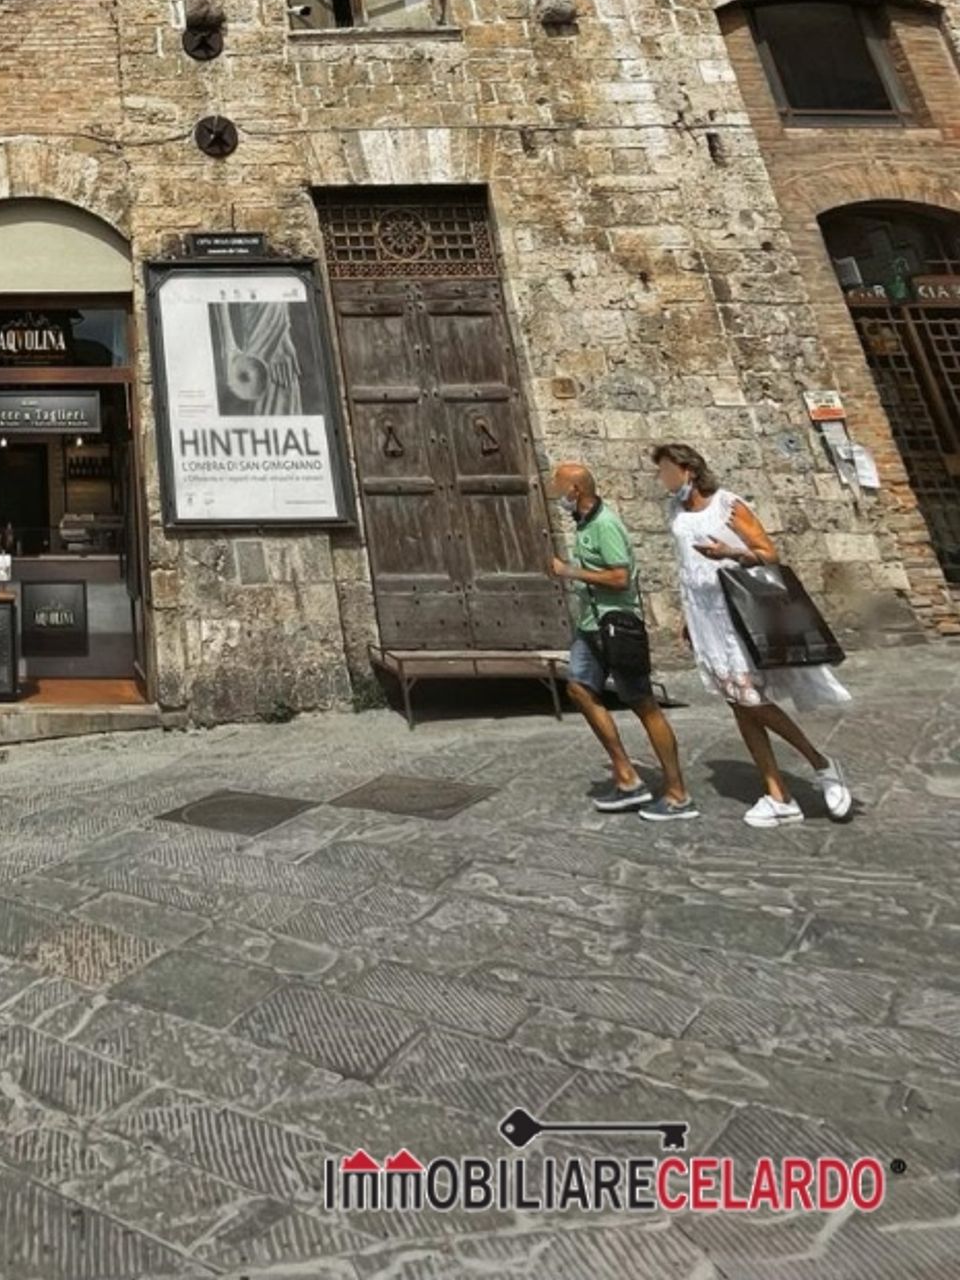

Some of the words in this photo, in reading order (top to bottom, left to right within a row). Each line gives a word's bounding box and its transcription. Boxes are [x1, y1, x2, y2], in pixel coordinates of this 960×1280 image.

[179, 428, 321, 457] HINTHIAL
[227, 460, 238, 471] DI
[239, 460, 259, 471] SAN
[262, 460, 323, 471] GIMIGNANO
